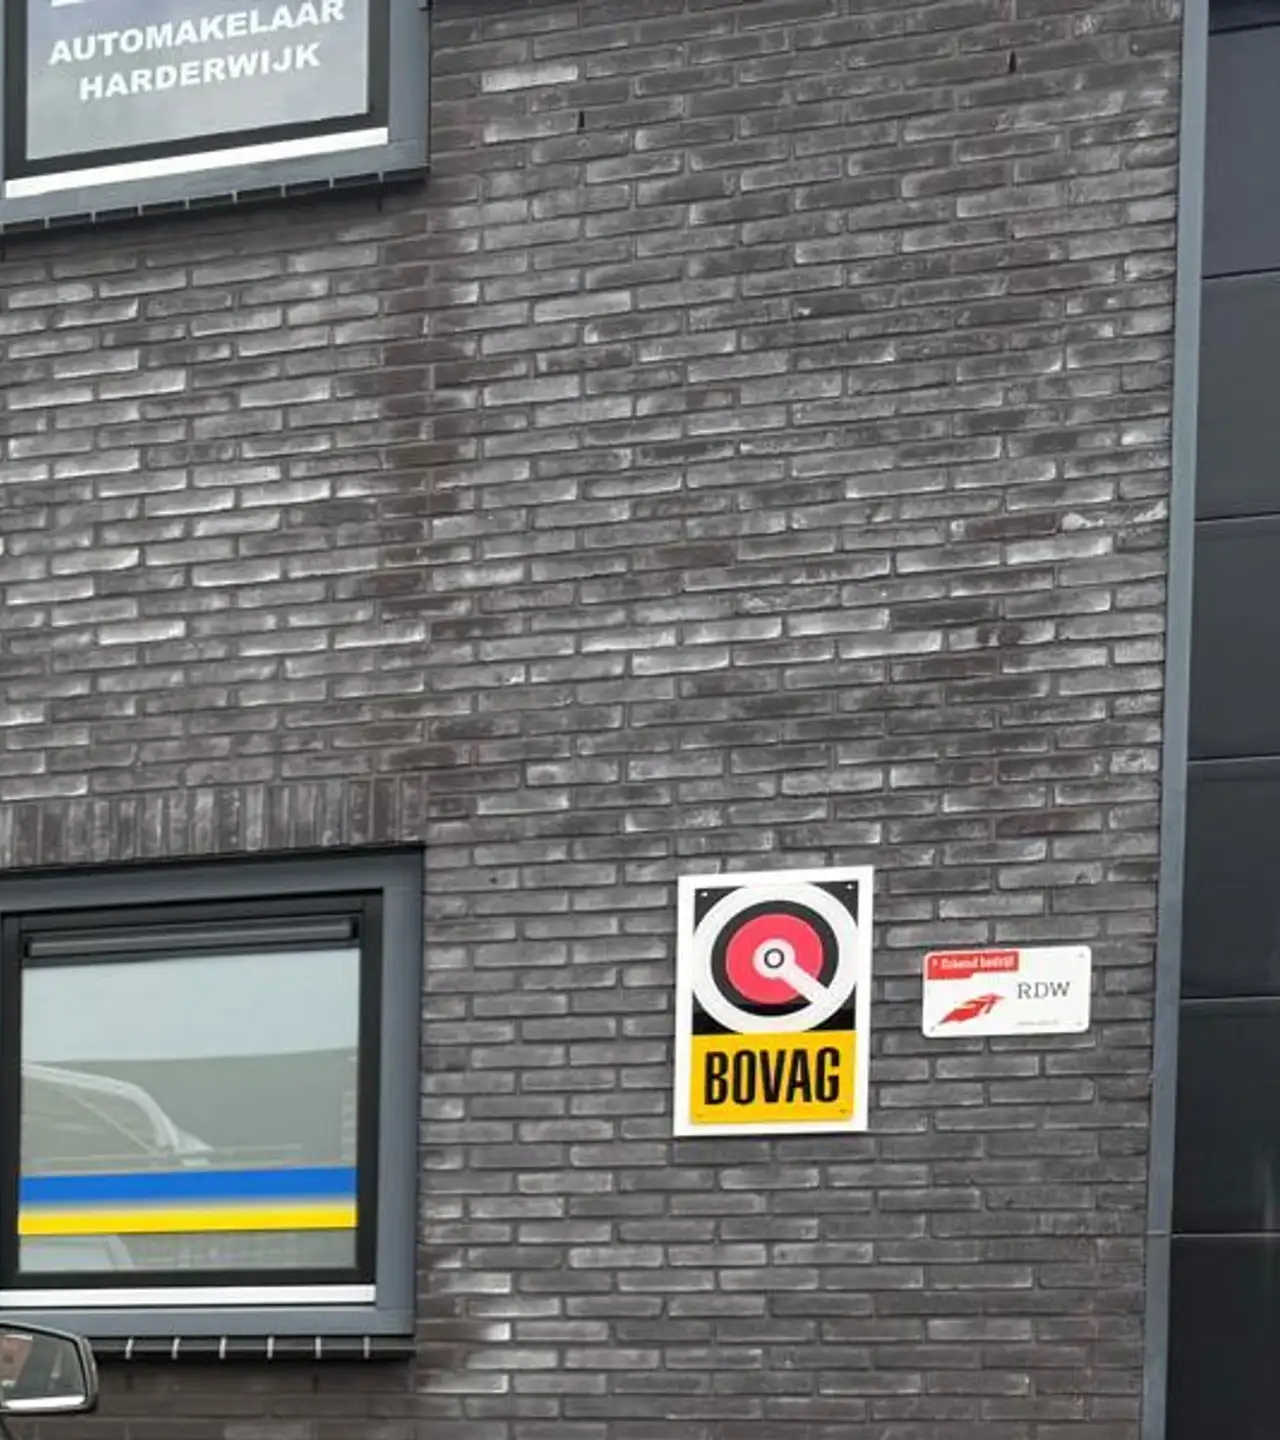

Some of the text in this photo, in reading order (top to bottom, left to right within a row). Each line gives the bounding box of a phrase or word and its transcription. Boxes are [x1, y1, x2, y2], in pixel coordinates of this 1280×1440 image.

[48, 0, 345, 65] AUTOMAKELAAR
[79, 42, 321, 102] HARDERWIJK
[1017, 981, 1070, 999] RDW
[704, 1046, 840, 1106] BOVAG
